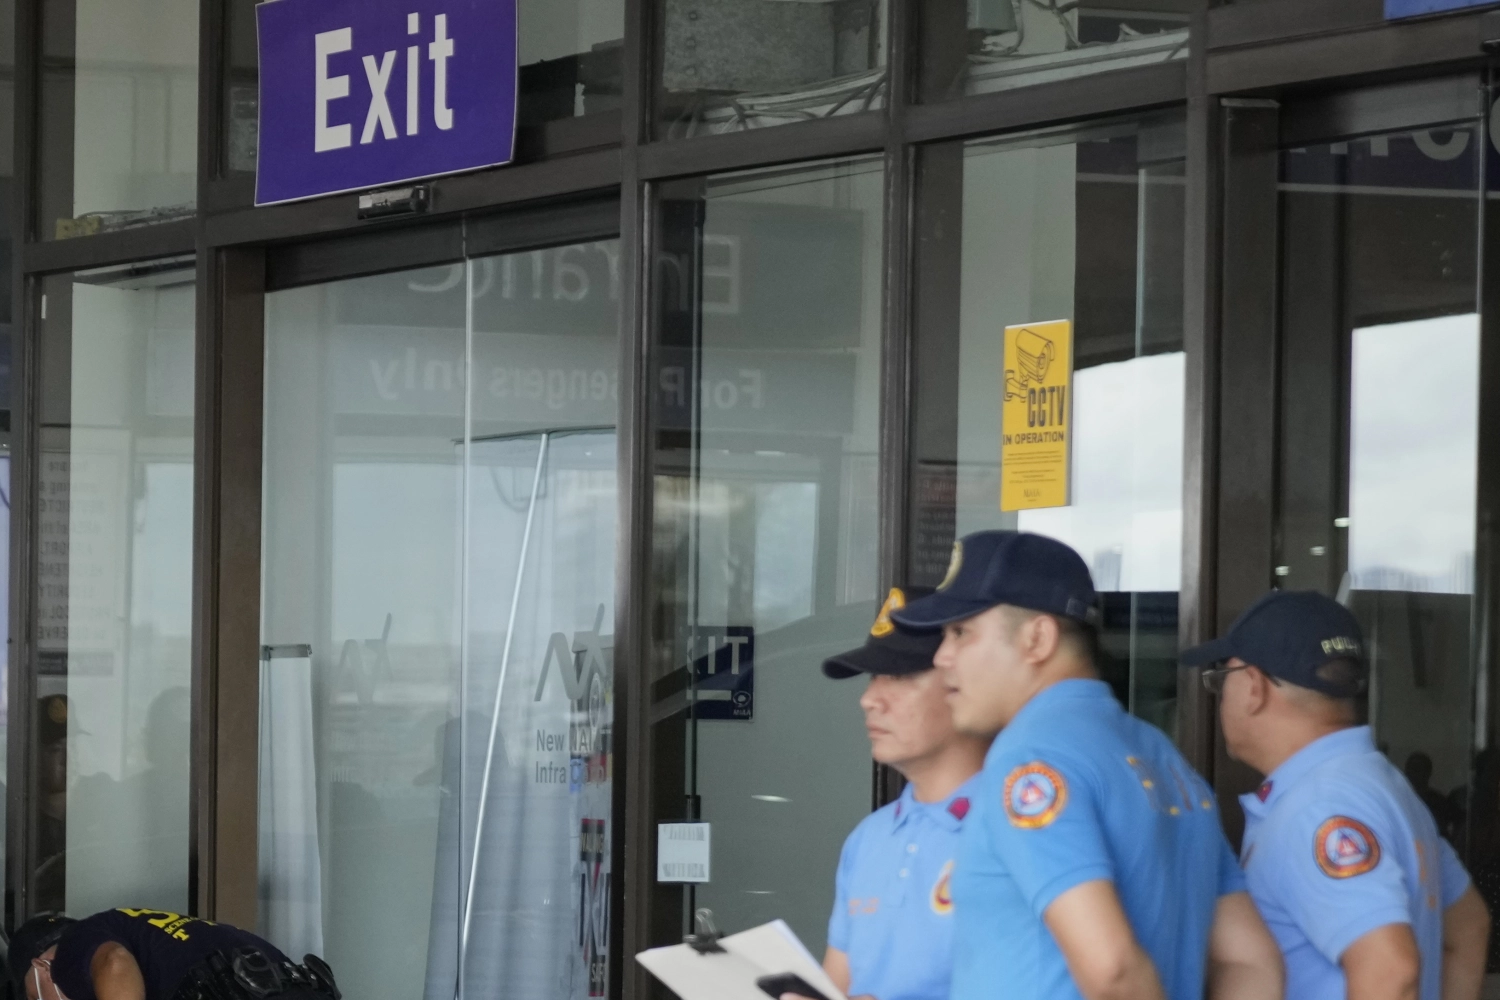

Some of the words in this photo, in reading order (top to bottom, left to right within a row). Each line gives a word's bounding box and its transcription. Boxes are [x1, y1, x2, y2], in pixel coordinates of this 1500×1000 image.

[315, 13, 455, 153] Exit
[1028, 385, 1066, 428] CCTV
[1003, 434, 1012, 445] IN
[1015, 431, 1065, 445] OPERATION
[536, 729, 564, 751] New
[536, 761, 566, 783] Infra
